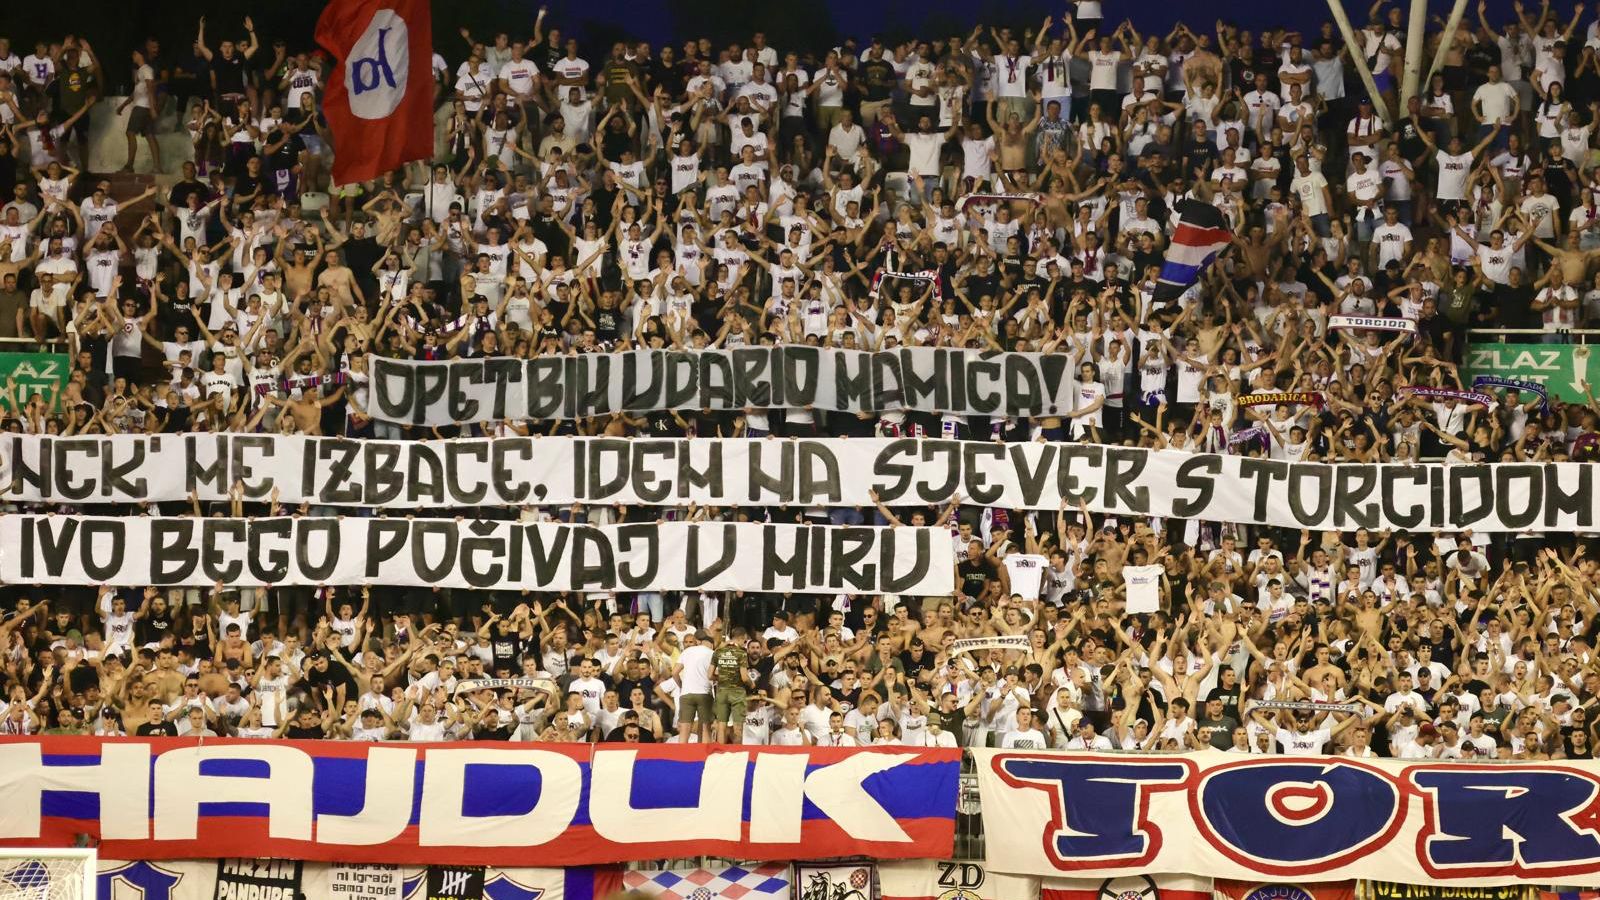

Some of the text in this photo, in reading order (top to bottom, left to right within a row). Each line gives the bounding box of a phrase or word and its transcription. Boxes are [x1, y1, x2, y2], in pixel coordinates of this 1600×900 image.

[1346, 318, 1406, 328] TORCIDA
[0, 360, 60, 379] AZ
[374, 358, 522, 424] OPET
[527, 354, 610, 418] BIH
[622, 346, 819, 411] UDARIO
[1239, 393, 1308, 405] BRODARICA
[186, 435, 275, 497] ME
[574, 440, 724, 503] IDEM
[748, 440, 842, 503] NA
[872, 438, 1150, 513] SJEVER
[1172, 454, 1223, 517] S
[1239, 458, 1593, 529] TORCIDOM
[20, 516, 931, 593] IVO BEGO POČIVAJ U MIRU
[473, 679, 534, 687] TORCIDA
[0, 742, 923, 847] HAJDUK
[937, 861, 985, 889] ZD
[217, 880, 295, 900] PANDURE
[332, 883, 397, 896] samo boje
